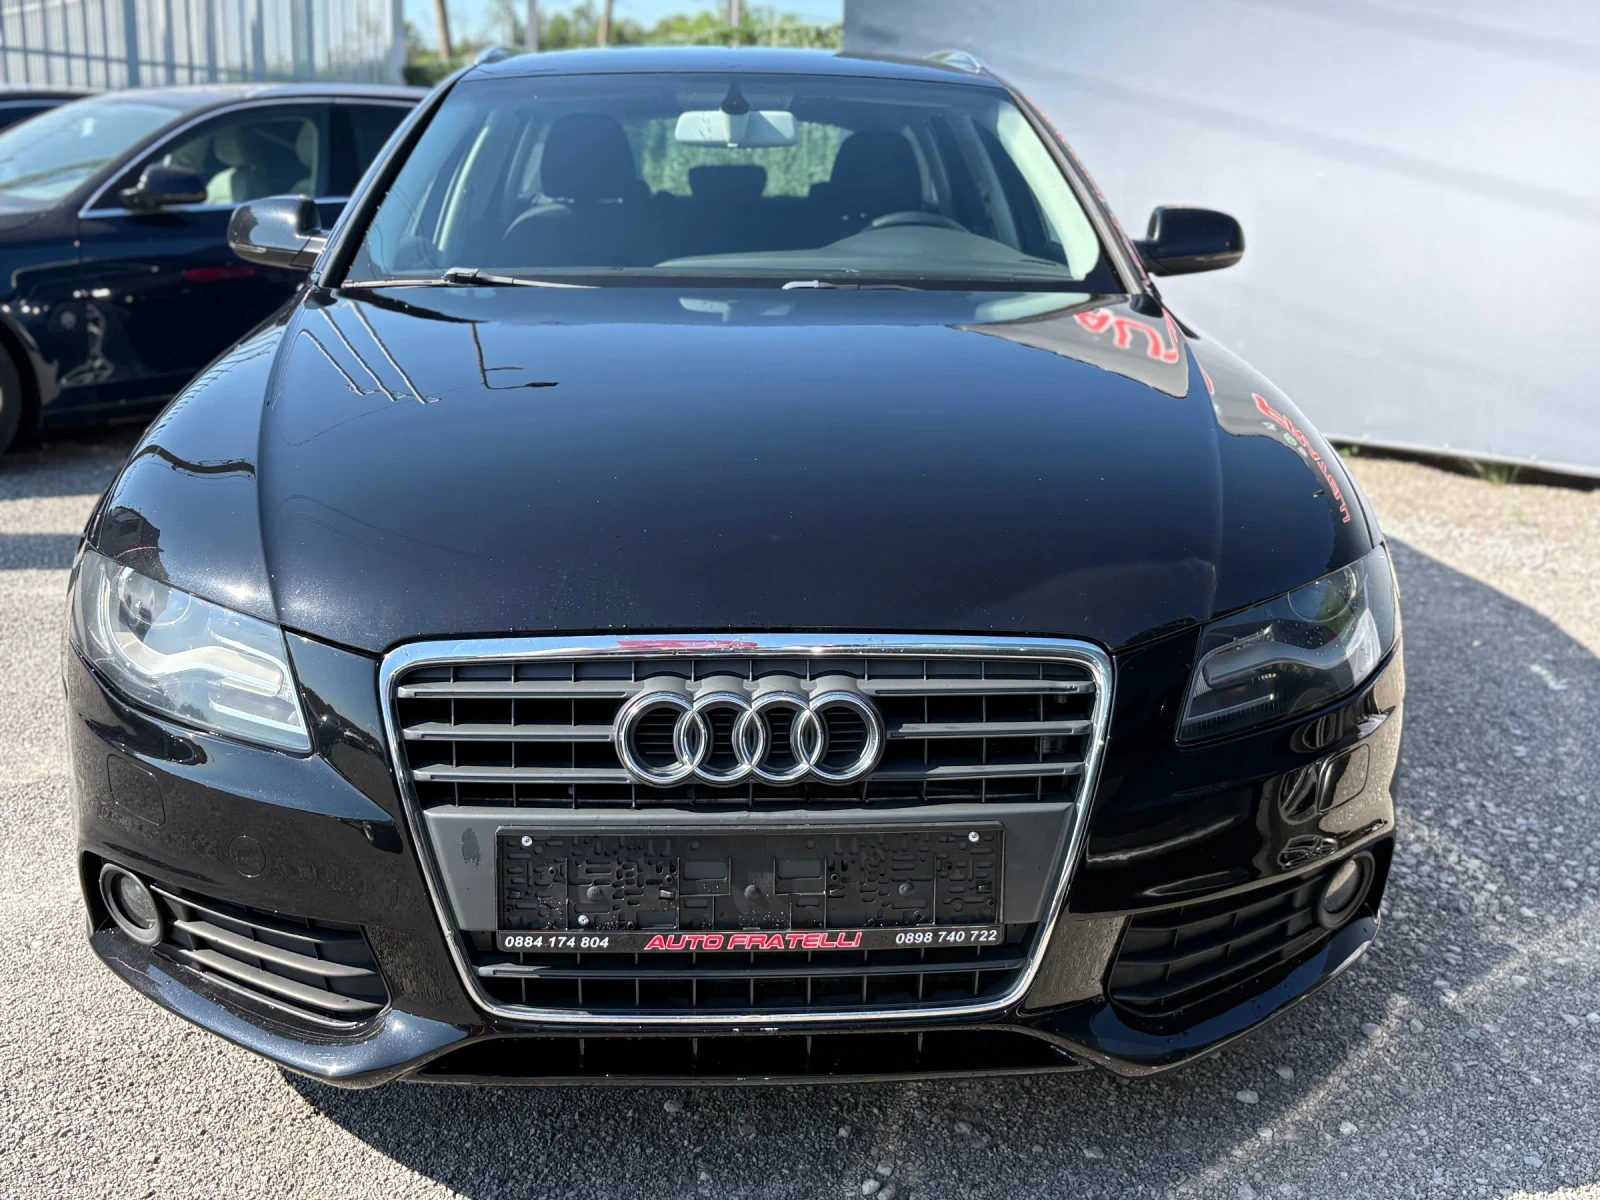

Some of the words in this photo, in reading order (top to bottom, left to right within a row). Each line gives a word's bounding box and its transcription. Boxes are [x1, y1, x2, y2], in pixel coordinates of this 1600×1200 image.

[504, 935, 543, 948] 0884
[548, 936, 576, 948] 174
[580, 936, 609, 948] 804
[644, 934, 724, 950] AUTO
[727, 931, 863, 950] FRATELLI
[895, 931, 933, 944] 0898
[937, 930, 966, 943] 740
[969, 929, 998, 942] 722
